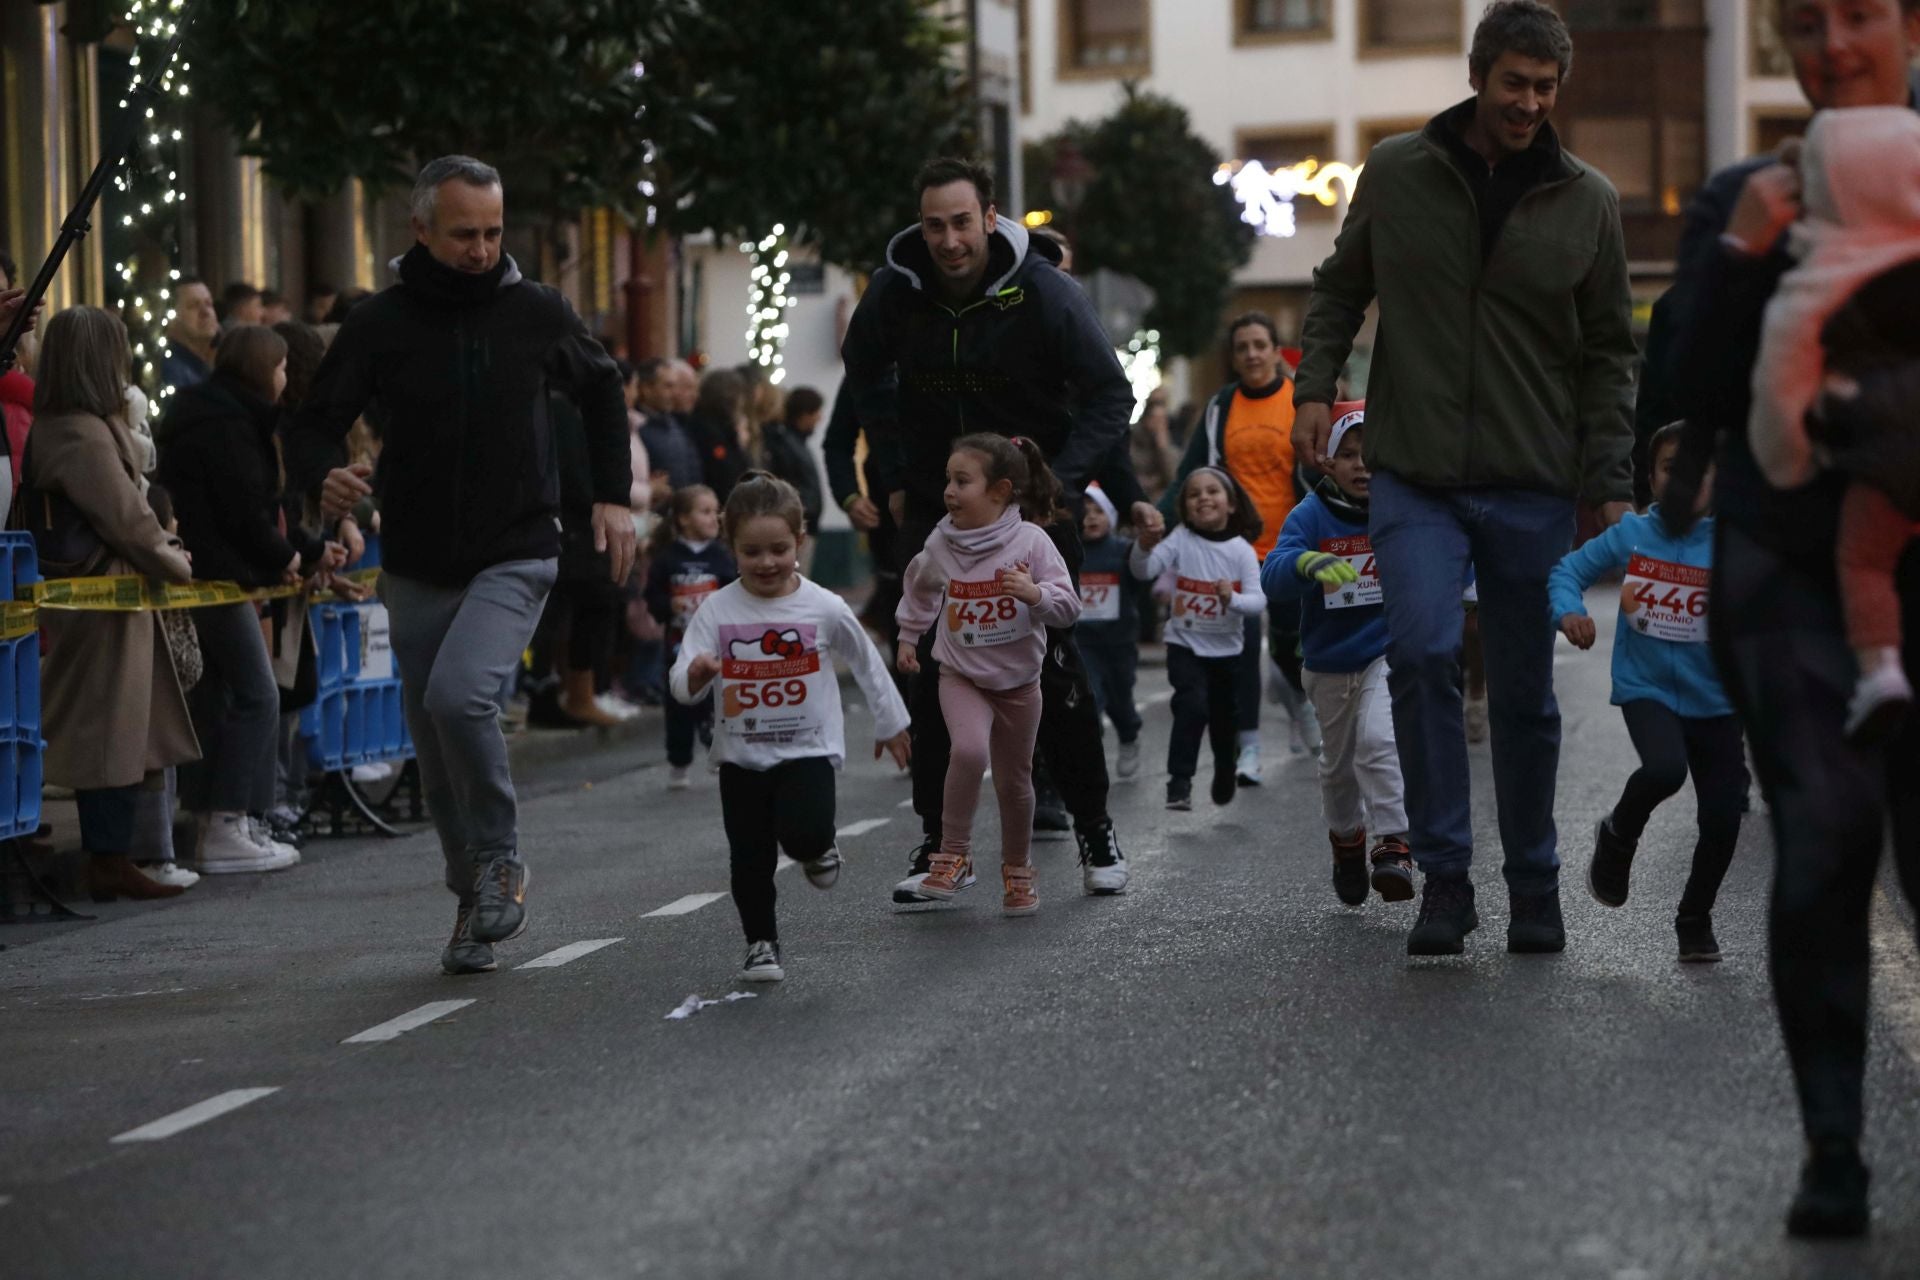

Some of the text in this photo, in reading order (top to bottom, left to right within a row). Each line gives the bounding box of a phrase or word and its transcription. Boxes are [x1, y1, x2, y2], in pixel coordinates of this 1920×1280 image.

[958, 597, 1017, 625] 428
[1633, 582, 1710, 617] 446
[1644, 610, 1694, 625] ANTONIO
[739, 679, 807, 709] 569
